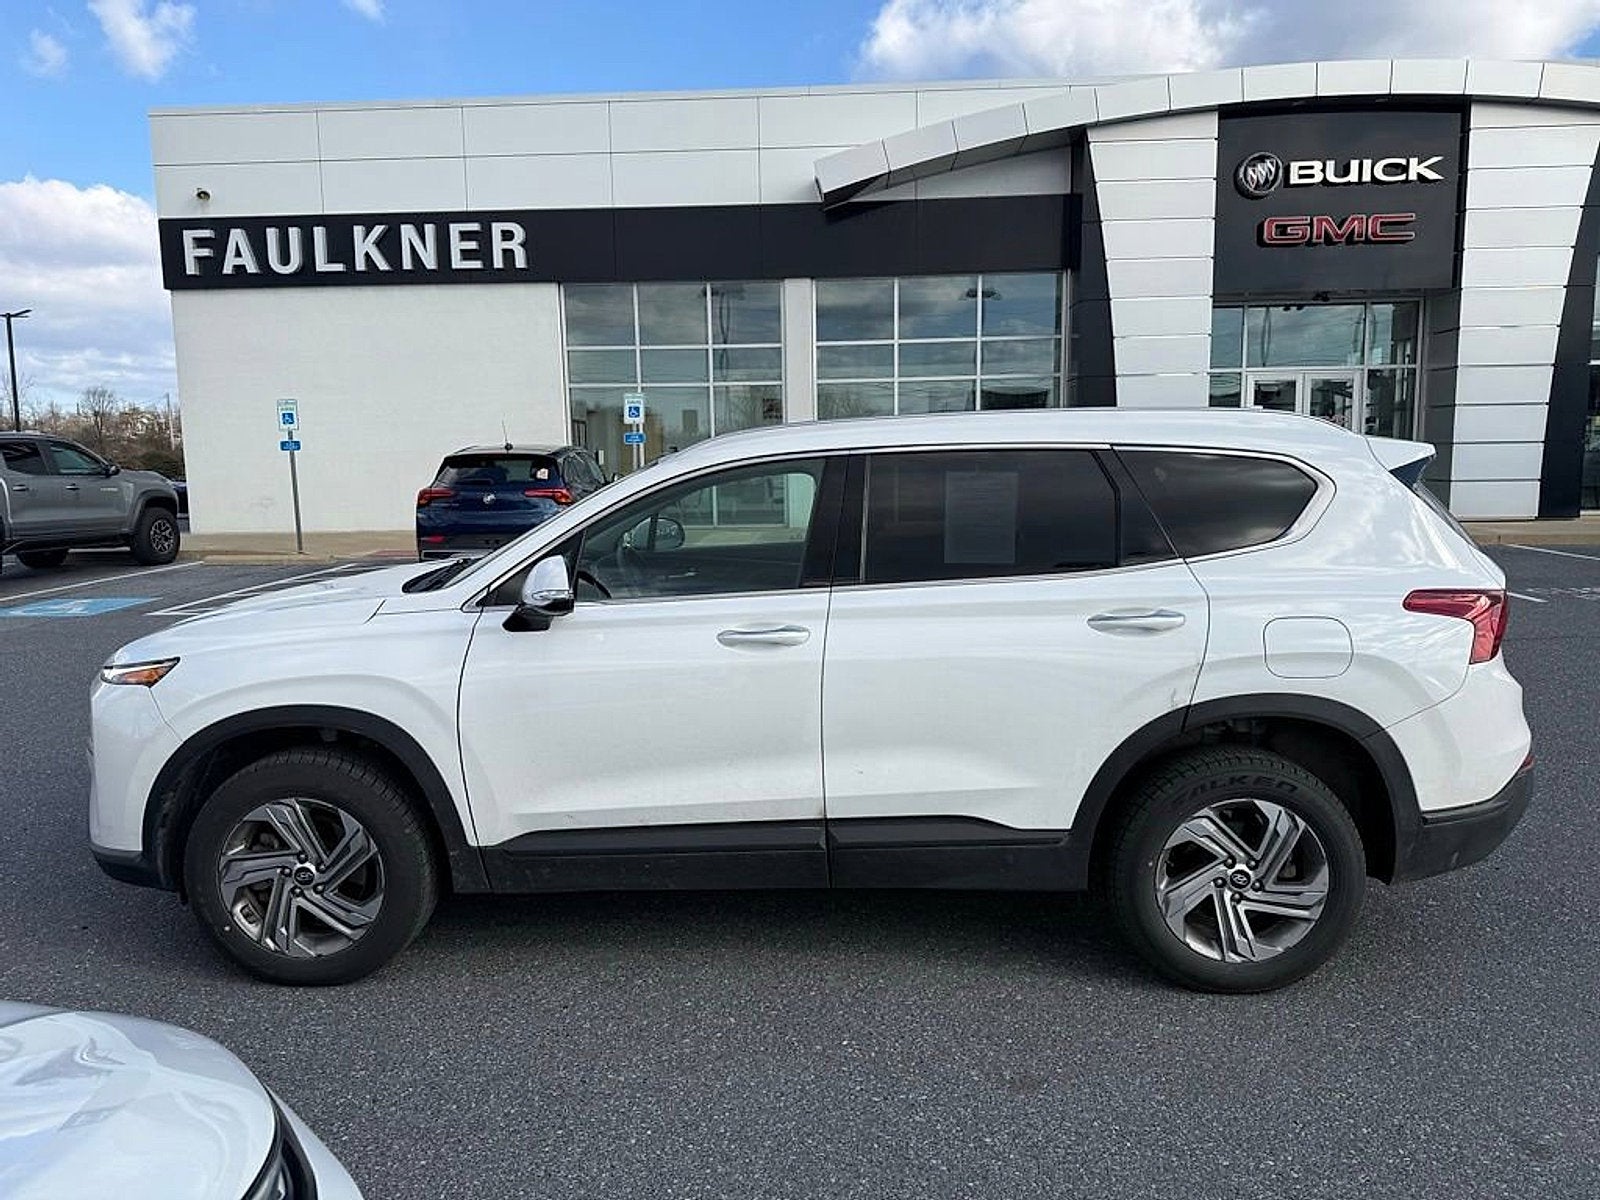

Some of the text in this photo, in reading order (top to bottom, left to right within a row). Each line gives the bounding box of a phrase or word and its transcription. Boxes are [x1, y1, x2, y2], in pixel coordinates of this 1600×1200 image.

[1289, 156, 1445, 185] BUICK
[1262, 212, 1416, 244] GMC
[182, 221, 529, 276] FAULKNER
